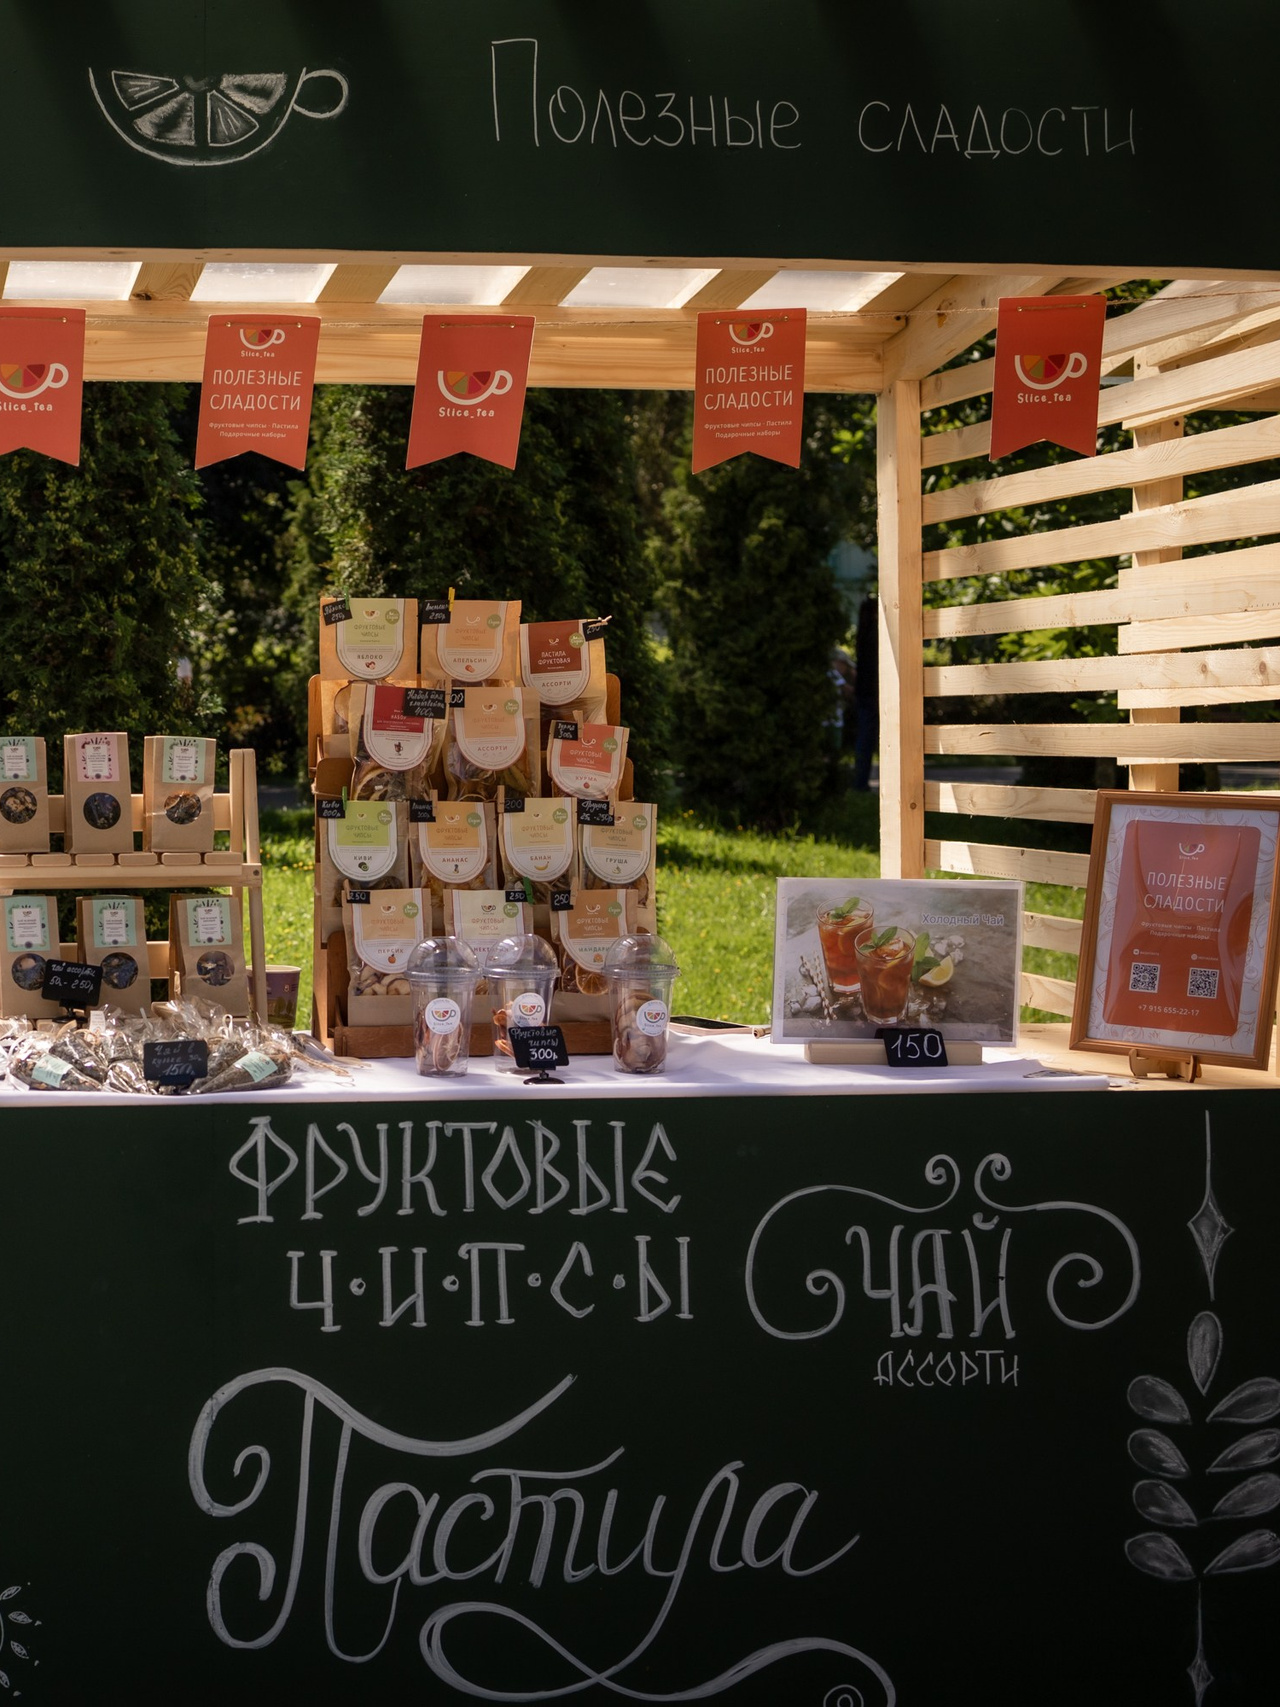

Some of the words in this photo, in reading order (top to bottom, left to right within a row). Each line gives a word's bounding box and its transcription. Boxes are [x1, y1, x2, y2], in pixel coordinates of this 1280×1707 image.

[213, 369, 303, 386] ПОЛЕЗНЫЕ
[706, 365, 793, 384] ПОЛЕЗНЫЕ
[210, 394, 301, 411] СЛАДОСТИ
[704, 390, 793, 410] СЛАДОСТИ
[1017, 393, 1072, 404] Slice_Tea
[438, 407, 495, 418] Slice_Tea
[715, 431, 755, 439] Подарочные
[1147, 872, 1227, 891] ПОЛЕЗНЫЕ
[349, 892, 367, 900] 250
[509, 892, 526, 900] 250
[554, 893, 570, 906] 250
[1144, 894, 1225, 913] СЛАДОСТИ
[922, 914, 979, 926] Холодный
[981, 914, 1004, 926] Чай
[510, 1027, 557, 1040] Фруктовые
[527, 1038, 559, 1047] чипсы
[891, 1033, 943, 1059] 150
[228, 1115, 682, 1223] ФРУКТОВЫЕ
[845, 1212, 1017, 1339] ЧАЙ
[872, 1348, 1021, 1387] АССОРТИ
[188, 1367, 861, 1690] Пастила
